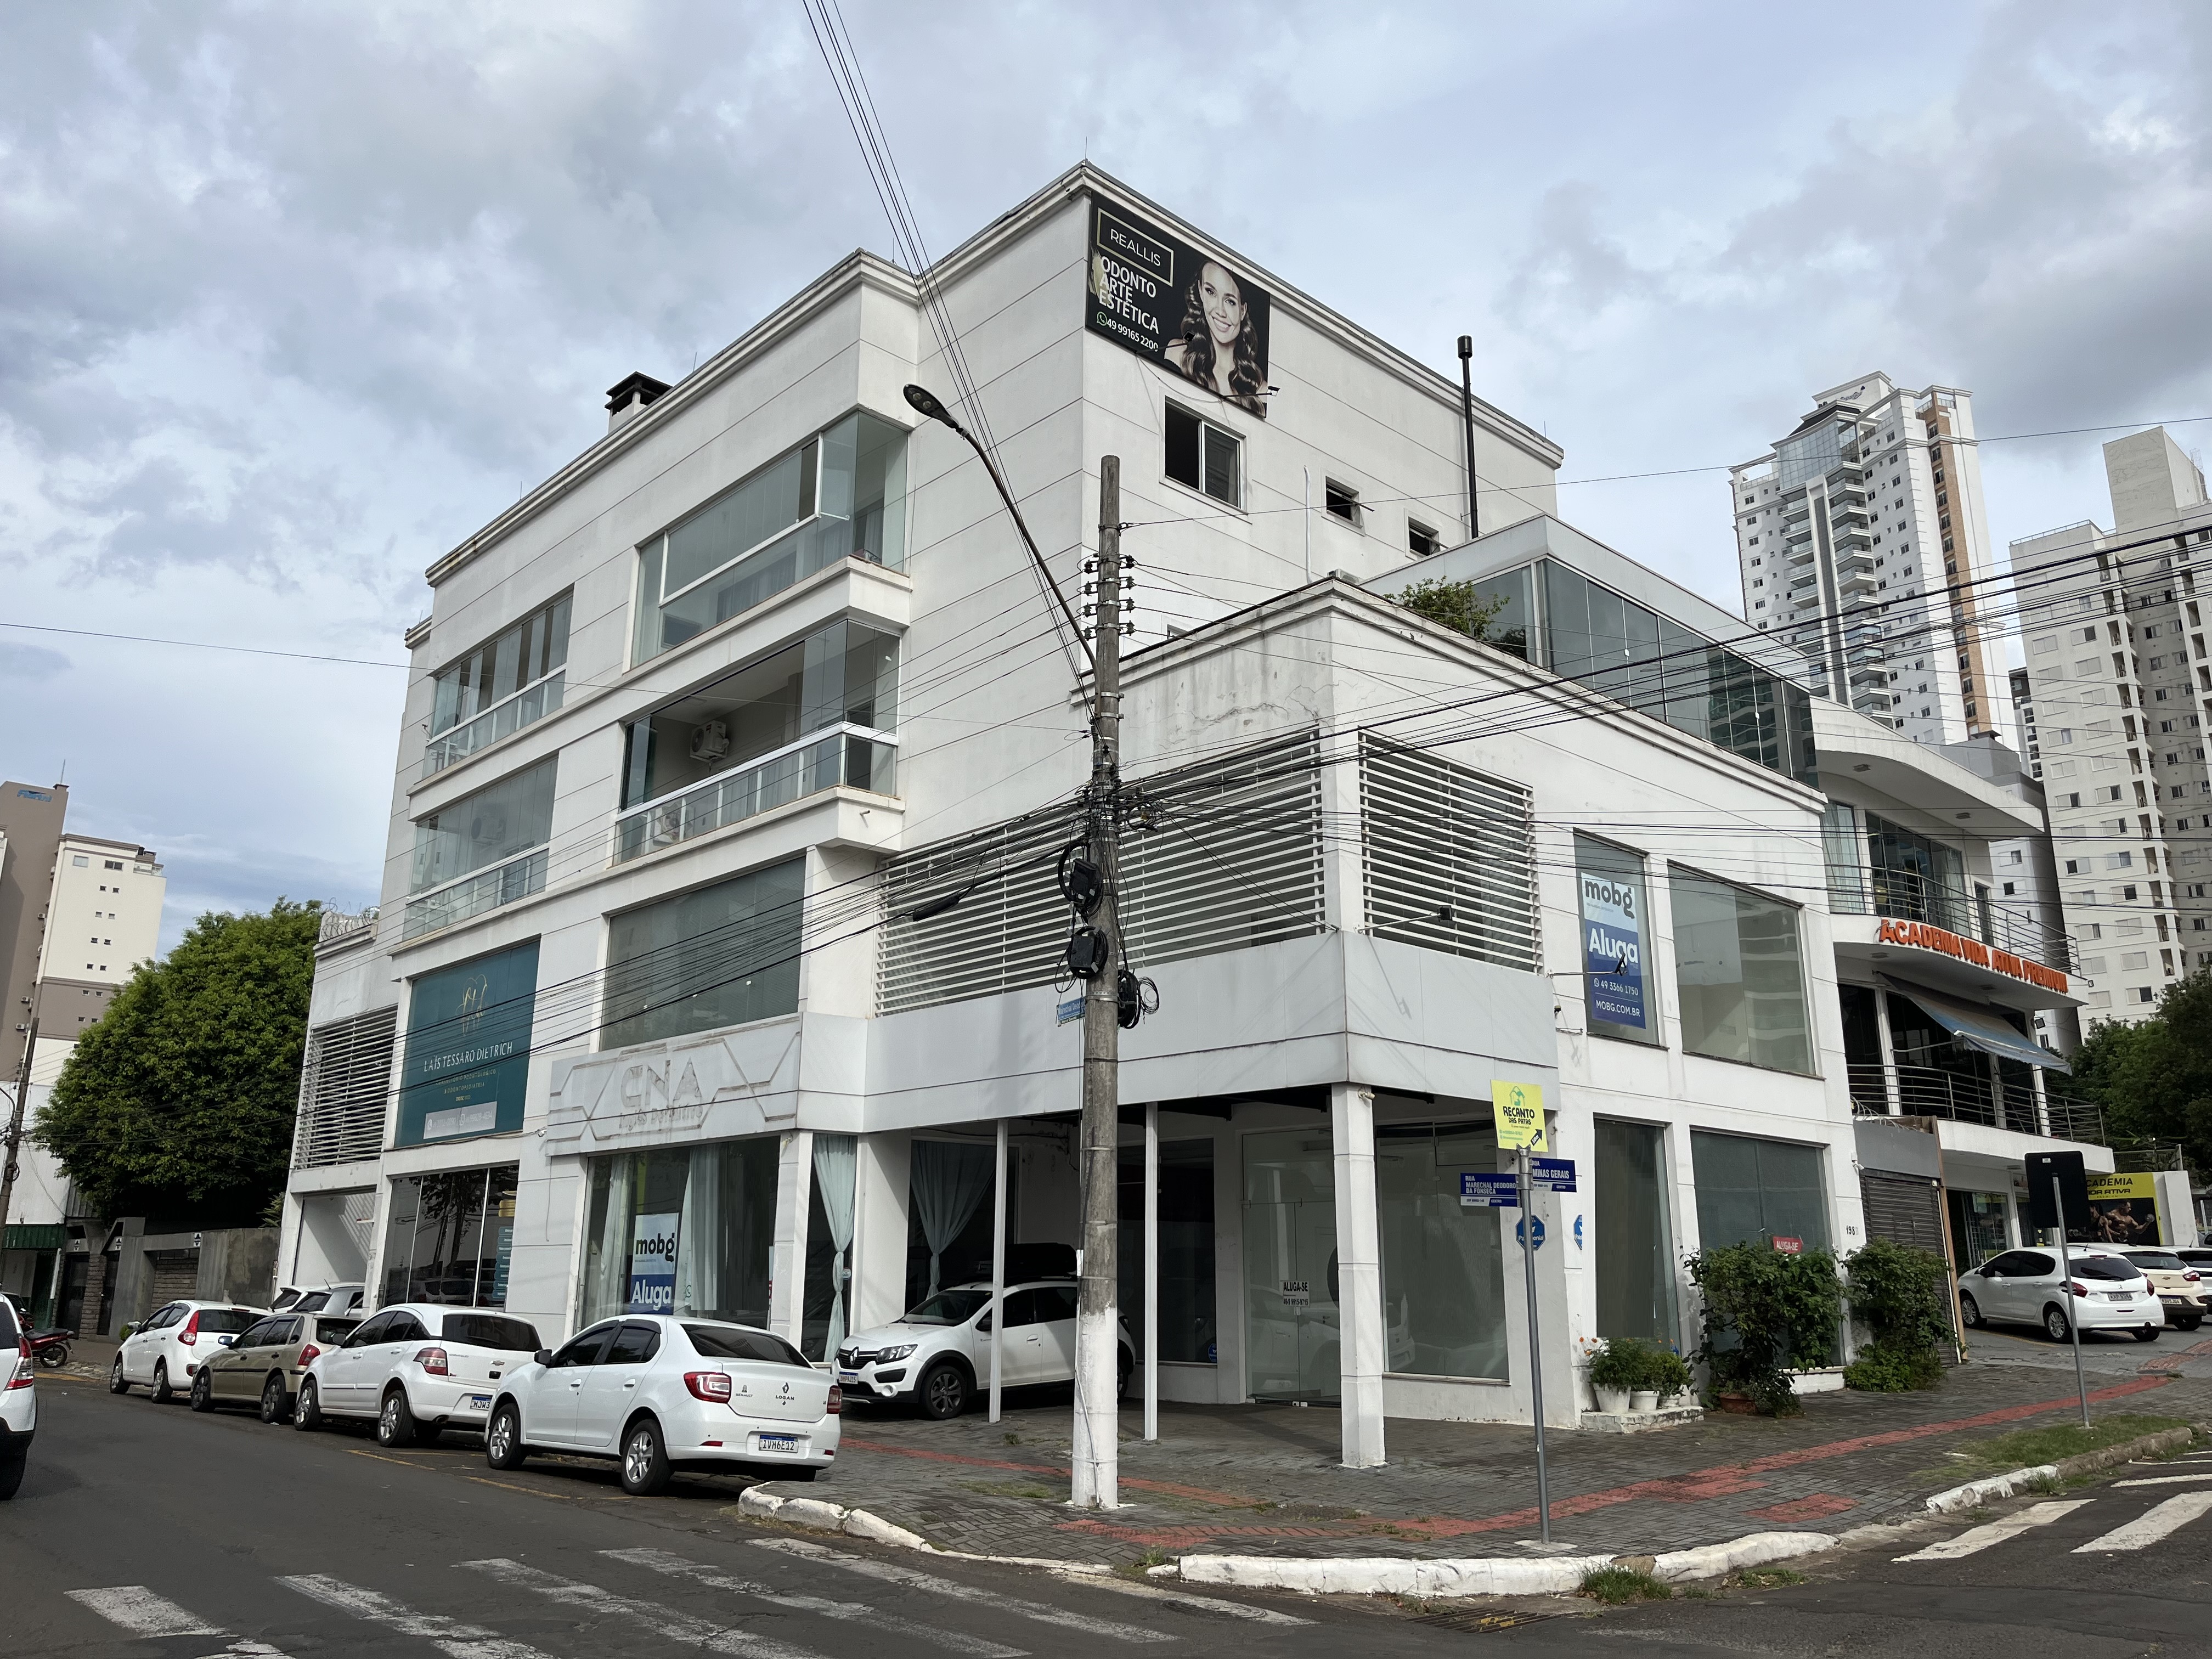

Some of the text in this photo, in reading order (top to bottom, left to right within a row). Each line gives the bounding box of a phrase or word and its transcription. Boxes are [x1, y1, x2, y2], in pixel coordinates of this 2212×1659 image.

[1110, 228, 1161, 267] REALLIS
[1099, 274, 1133, 303] ARTE
[1100, 256, 1156, 298] ODONTO
[1099, 290, 1159, 335] ESTÉTICA
[1107, 318, 1159, 352] 49 99165 2200
[1584, 880, 1635, 919] mobg
[1588, 927, 1639, 968] Aluga
[1879, 919, 2068, 995] ACADEMIA VIDA ATIVA PREMIUM
[1600, 980, 1639, 996] 49 3366 1750
[1595, 1000, 1640, 1017] MOBG.COM.BR
[443, 1049, 475, 1068] TESSARO
[476, 1041, 514, 1061] DIETRICH
[620, 1057, 702, 1108] CNA
[1503, 1105, 1535, 1119] RECANTO
[1532, 1169, 1570, 1180] MINAS GERAIS
[2086, 1177, 2134, 1187] CADEMIA
[635, 1232, 675, 1262] mobg
[631, 1279, 672, 1311] Aluga
[1284, 1282, 1308, 1291] ALUGA-SE
